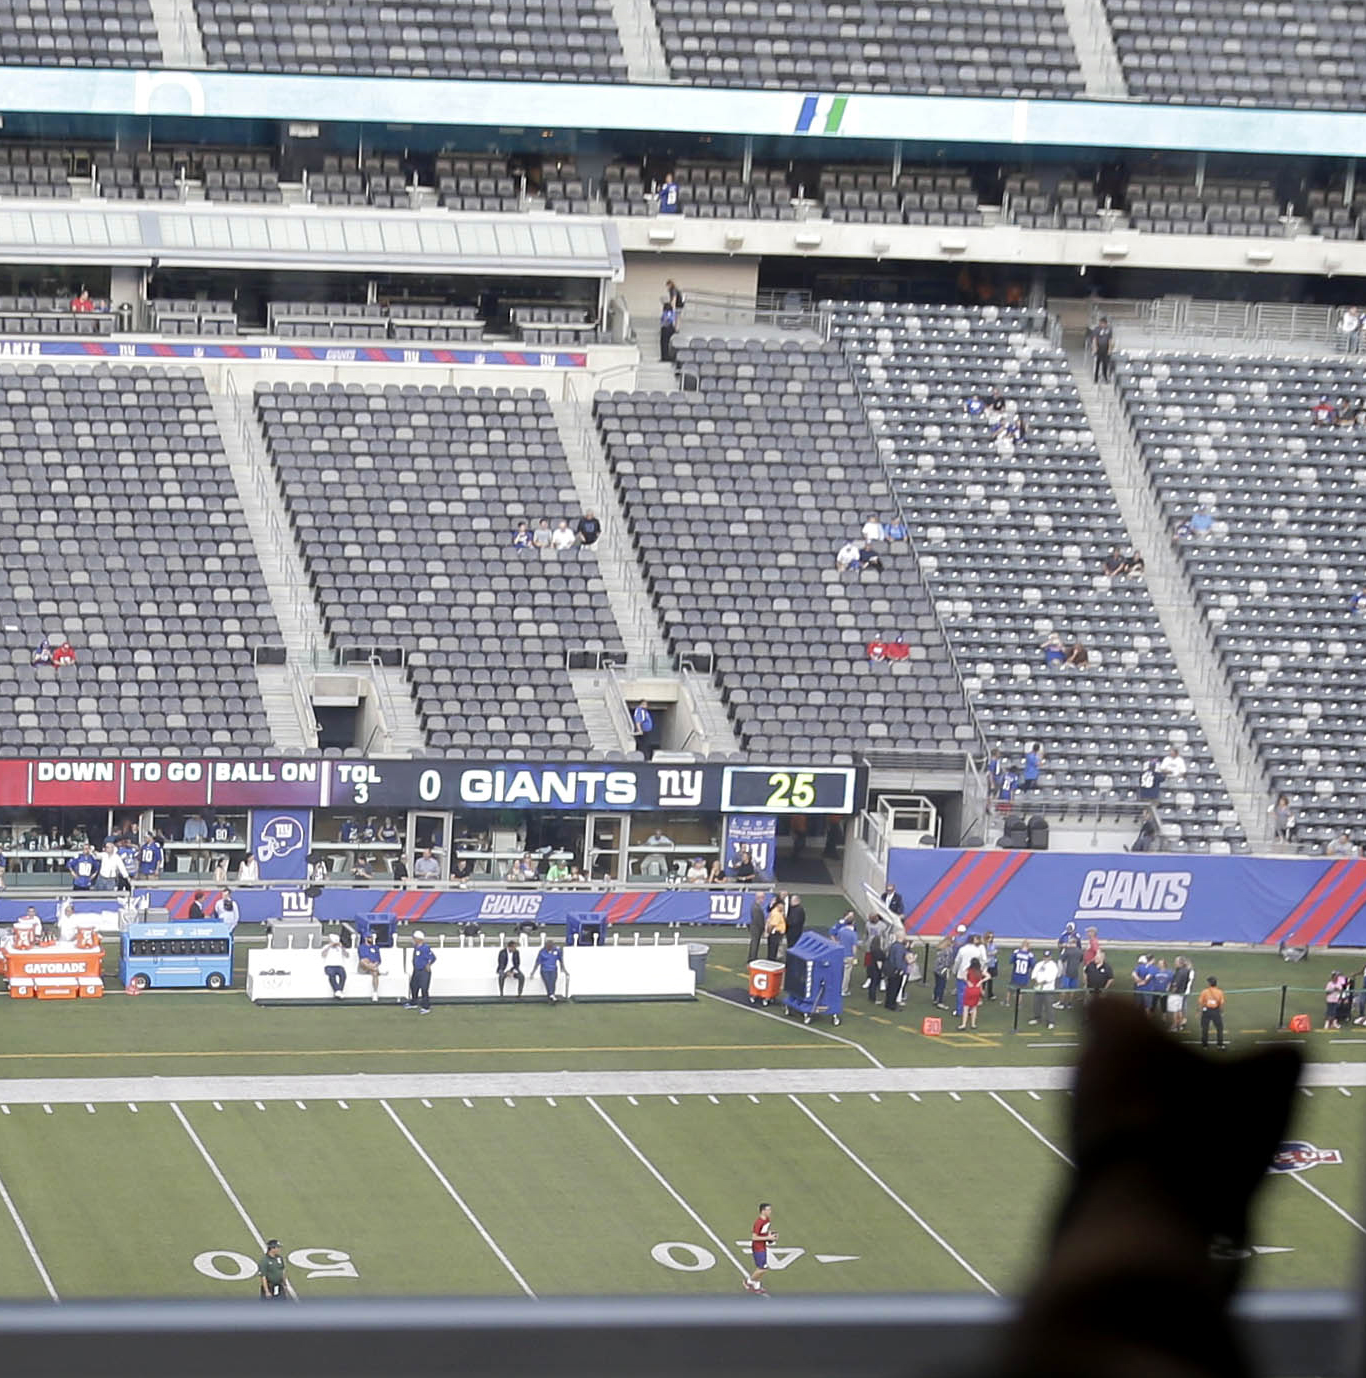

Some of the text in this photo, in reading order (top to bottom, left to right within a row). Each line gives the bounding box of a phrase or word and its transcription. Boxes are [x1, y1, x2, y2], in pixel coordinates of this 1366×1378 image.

[37, 761, 114, 782] DOWN
[131, 761, 203, 782] TO GO
[214, 761, 317, 783] BALL ON
[337, 763, 382, 784] TOL
[354, 783, 370, 804] 3
[418, 769, 637, 803] 0 GIANTS
[766, 772, 816, 808] 25
[1079, 869, 1193, 912] GIANTS
[480, 894, 543, 914] GIANTS
[24, 962, 86, 974] GATORADE
[753, 973, 768, 990] G
